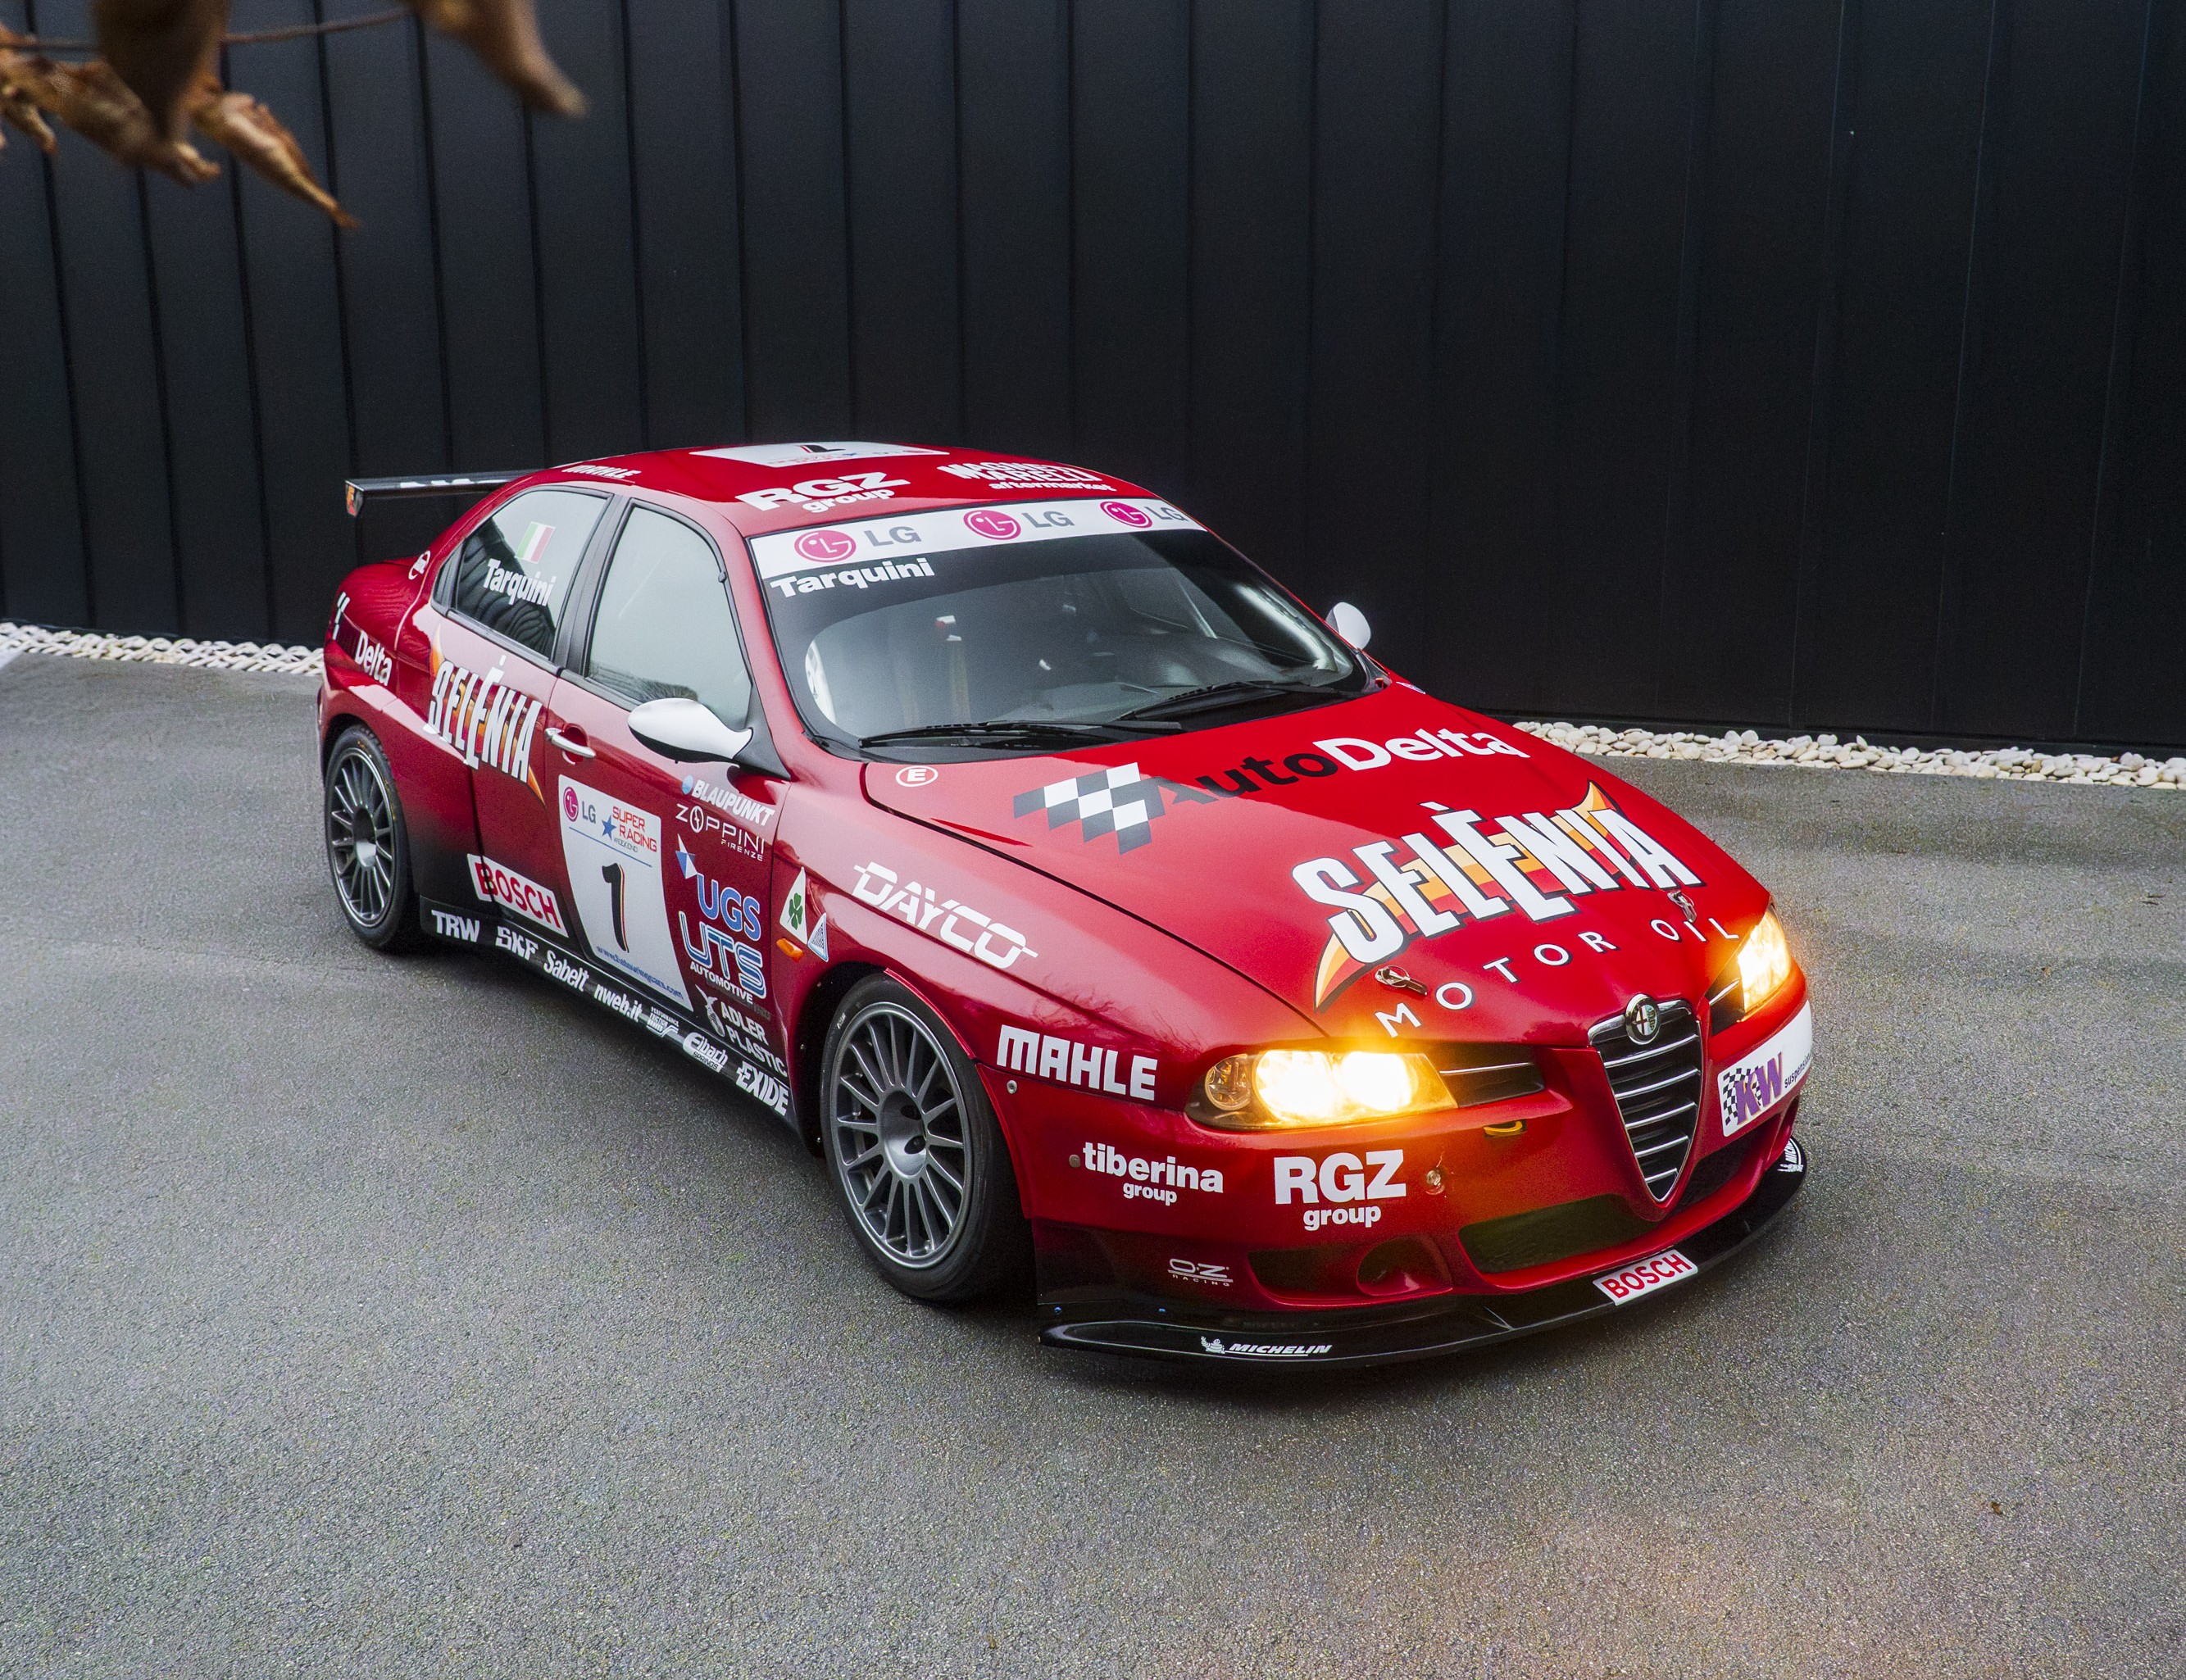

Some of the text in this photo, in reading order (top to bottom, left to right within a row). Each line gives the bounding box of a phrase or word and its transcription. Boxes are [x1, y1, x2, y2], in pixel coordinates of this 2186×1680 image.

[735, 471, 911, 511] RGZ
[802, 488, 895, 513] group
[864, 506, 1189, 547] LG LG LG
[483, 558, 557, 607] Tarquini
[770, 557, 935, 598] Tarquini
[354, 629, 393, 687] Delta
[1149, 728, 1530, 806] AutoDelta
[582, 800, 597, 824] LG
[612, 806, 646, 833] SUPER
[691, 779, 776, 827] BLAUPUNKT
[619, 824, 657, 852] RACING
[675, 803, 766, 855] ZOPPINI
[720, 838, 763, 862] FIRENZE
[475, 861, 561, 929] BOSCH
[602, 862, 629, 953] 1
[696, 872, 761, 942] UGS
[853, 860, 1038, 969] DAYCO
[431, 909, 480, 942] TRW
[495, 925, 539, 961] SKF
[543, 949, 589, 992] Sabelt
[594, 983, 643, 1023] nweb.it
[690, 960, 753, 1005] AUTOMOTIVE
[1375, 917, 1739, 1038] MOTOR OIL
[720, 1001, 770, 1046] ADLER
[683, 1032, 729, 1066] Eibach
[693, 1051, 719, 1070] SPRINGS
[725, 1024, 788, 1078] PLASTIC
[997, 1024, 1158, 1101] MAHLE
[736, 1060, 789, 1115] EXIDE
[1735, 1051, 1784, 1125] KW
[1083, 1142, 1224, 1193] tiberina
[1273, 1149, 1407, 1205] RGZ
[1123, 1182, 1178, 1206] group
[1303, 1205, 1381, 1230] group
[1172, 1274, 1230, 1287] RACING
[1599, 1253, 1693, 1300] BOSCH
[1229, 1343, 1333, 1355] MICHELIN
